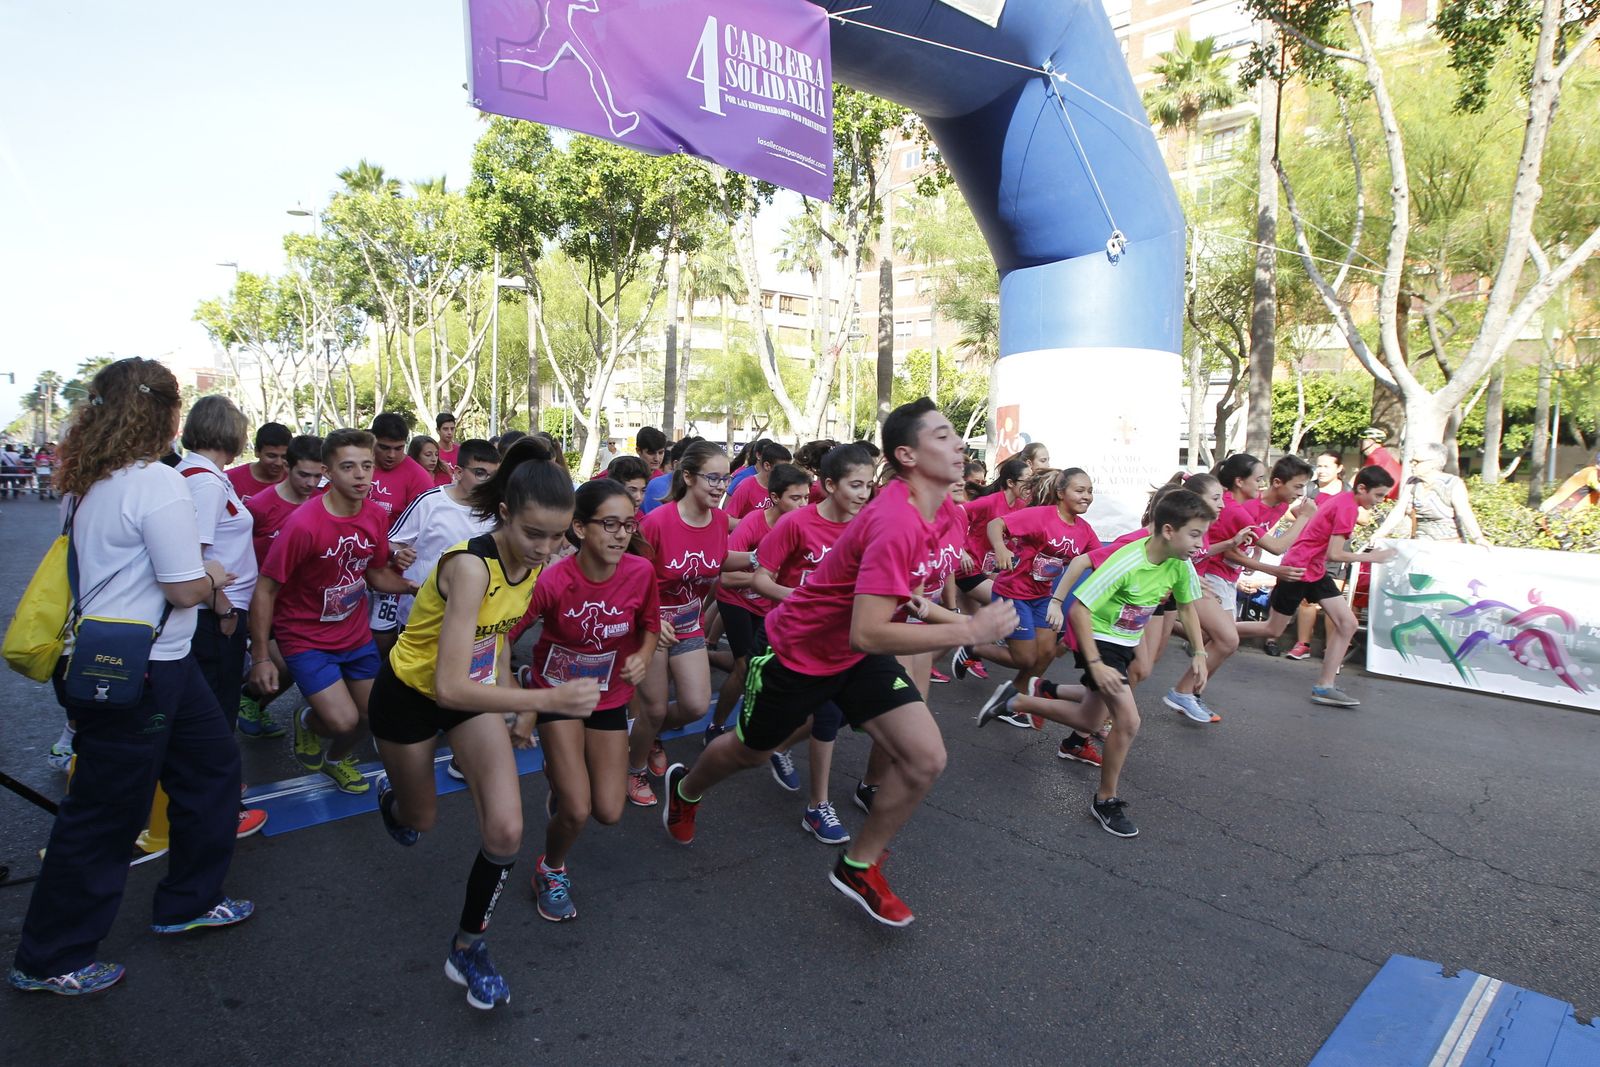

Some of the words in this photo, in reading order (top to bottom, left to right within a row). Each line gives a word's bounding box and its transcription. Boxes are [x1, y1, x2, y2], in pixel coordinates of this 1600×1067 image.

[686, 15, 728, 117] 4
[724, 23, 826, 91] CARRERA
[724, 57, 827, 119] SOLIDARIA
[724, 93, 737, 105] POR
[737, 97, 748, 108] LAS
[1083, 465, 1161, 474] YUNTAMIENTO
[378, 602, 397, 621] 86
[95, 654, 124, 666] RFEA
